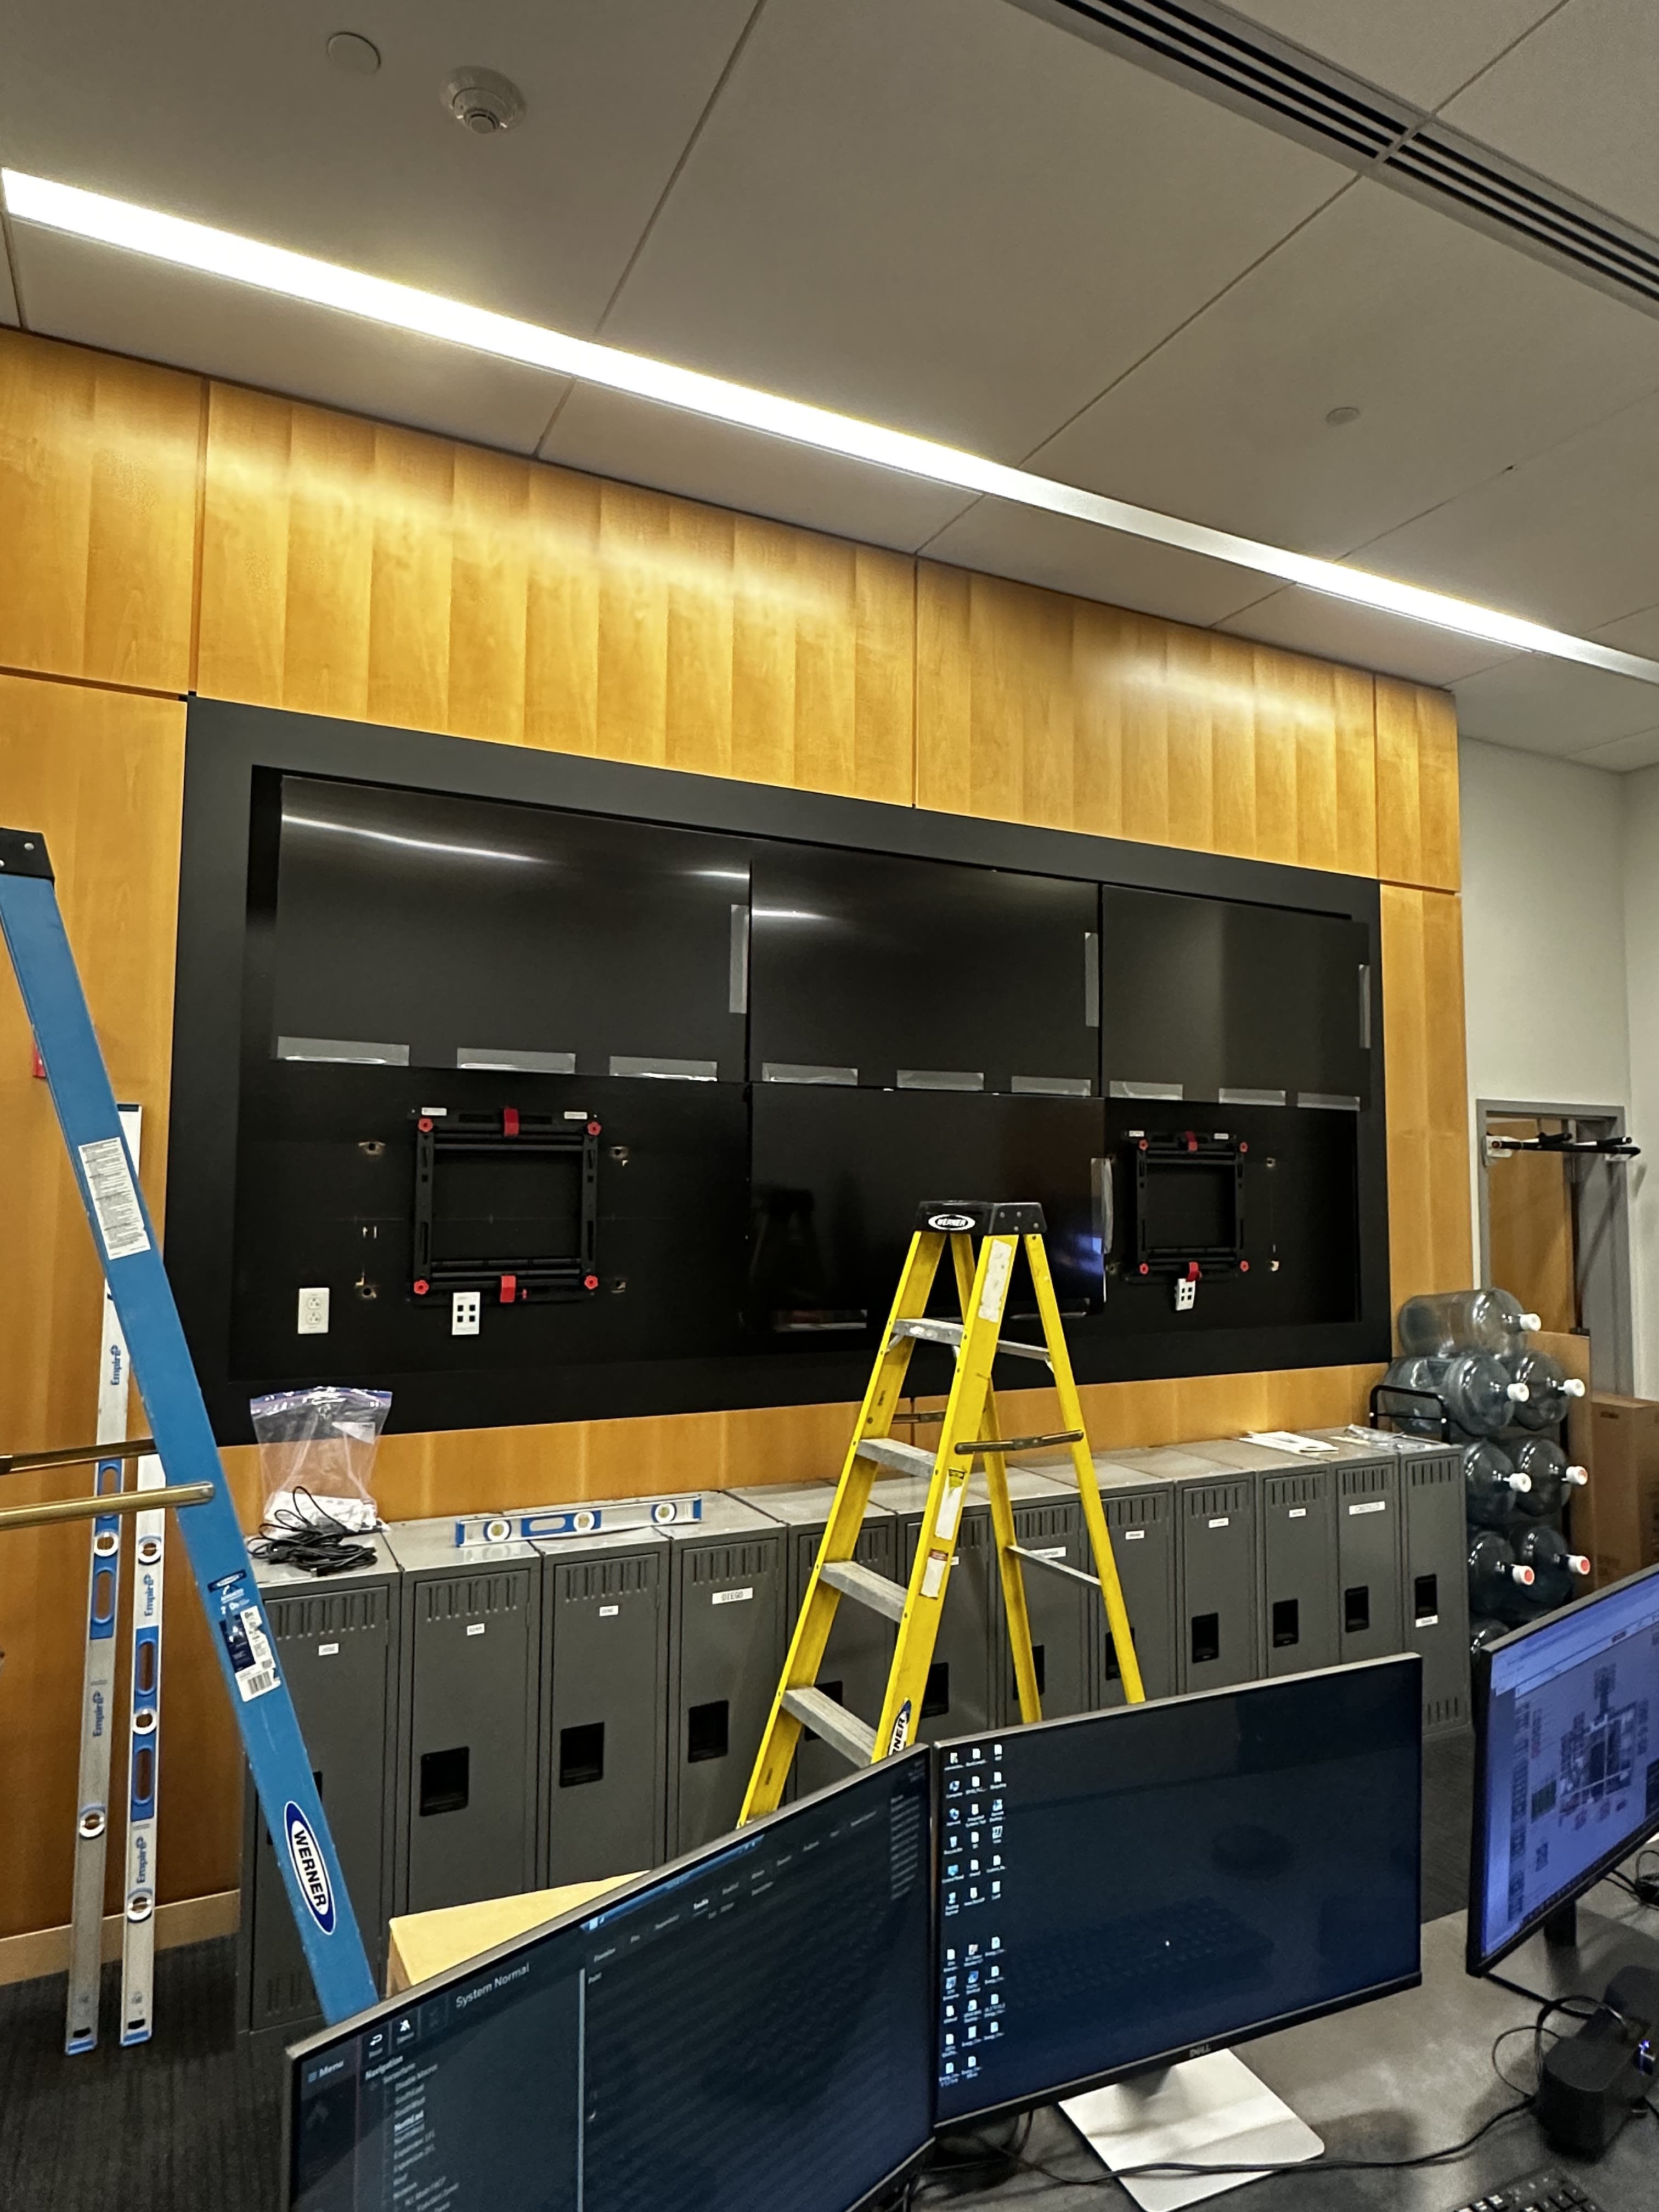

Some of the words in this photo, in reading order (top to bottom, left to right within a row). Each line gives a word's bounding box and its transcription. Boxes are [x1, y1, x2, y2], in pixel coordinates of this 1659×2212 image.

[111, 1345, 122, 1385] Empire
[144, 1573, 155, 1616] Empire
[722, 1591, 743, 1601] DIEGO
[93, 1691, 104, 1737] Empire
[893, 1717, 905, 1754] NER
[136, 1836, 148, 1883] Empire
[294, 1830, 326, 1907] WERNER
[456, 1983, 492, 2008] System
[494, 1962, 529, 1988] Normal
[319, 2060, 345, 2078] Menu
